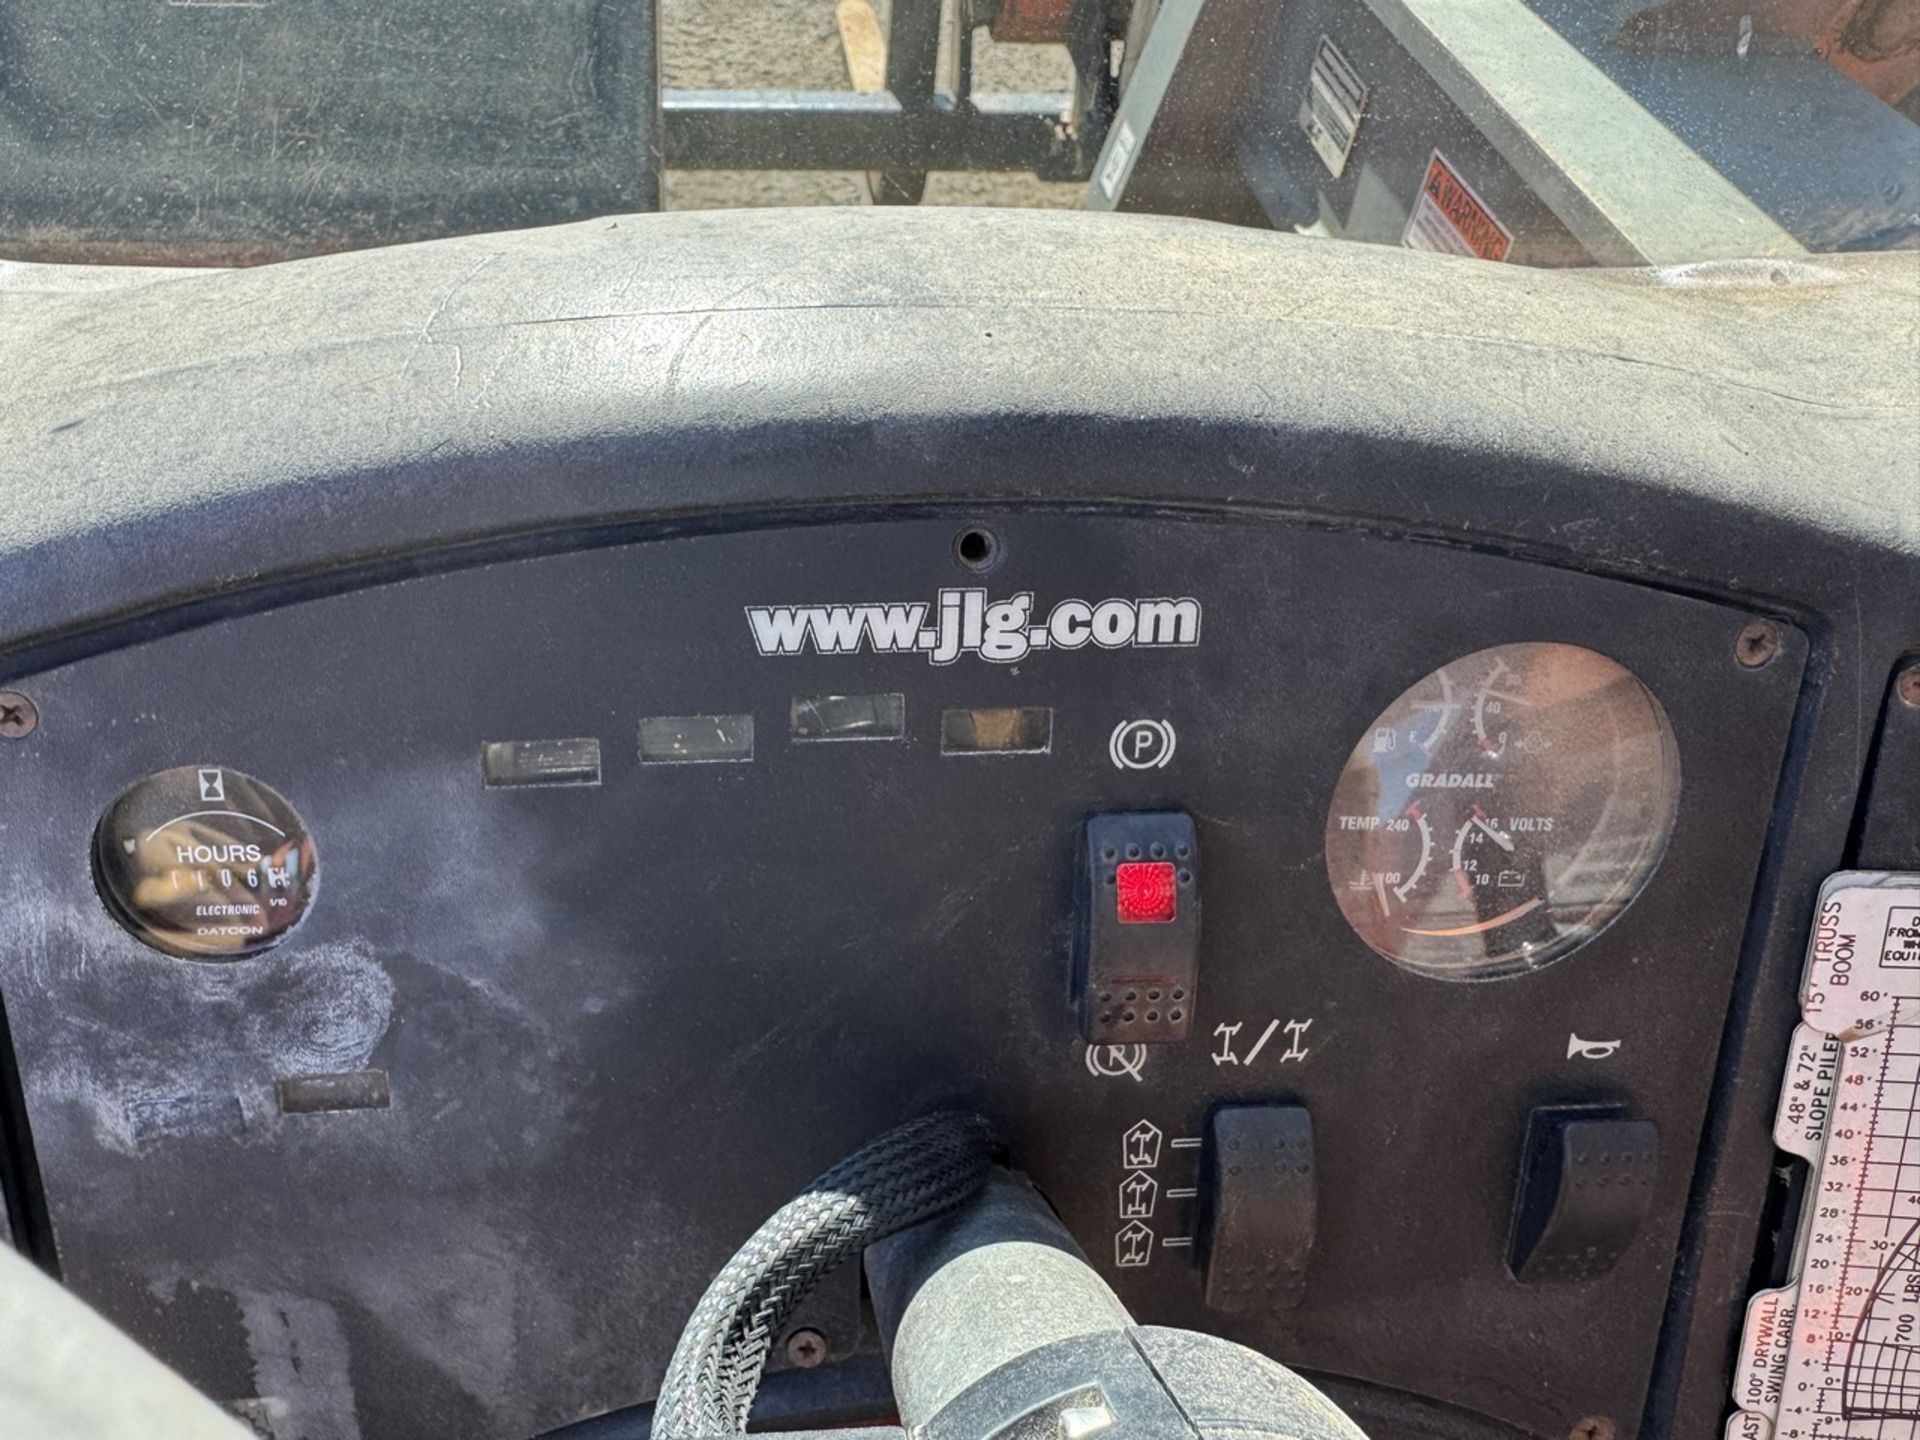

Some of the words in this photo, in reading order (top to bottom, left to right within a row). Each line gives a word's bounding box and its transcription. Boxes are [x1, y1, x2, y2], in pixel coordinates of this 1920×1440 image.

[744, 587, 1202, 665] www.jlg.com
[1134, 730, 1153, 759] P
[1406, 773, 1495, 789] GRADALL
[1339, 815, 1380, 831] TEMP
[1386, 819, 1410, 831] 240
[1510, 817, 1554, 831] VOLTS
[1469, 832, 1484, 844] 14
[176, 844, 262, 864] HOURS
[1463, 859, 1478, 871] 12
[1475, 873, 1490, 885] 10
[195, 905, 260, 917] ELECTRONIC
[197, 926, 264, 937] DATCON
[1812, 902, 1842, 963] TRUSS
[1829, 934, 1857, 986] BOOM
[1793, 1079, 1811, 1091] &
[1805, 1087, 1831, 1141] SLOPE
[1753, 1297, 1779, 1368] DRYWALL
[1894, 1314, 1915, 1342] 700
[1765, 1353, 1786, 1404] SWING
